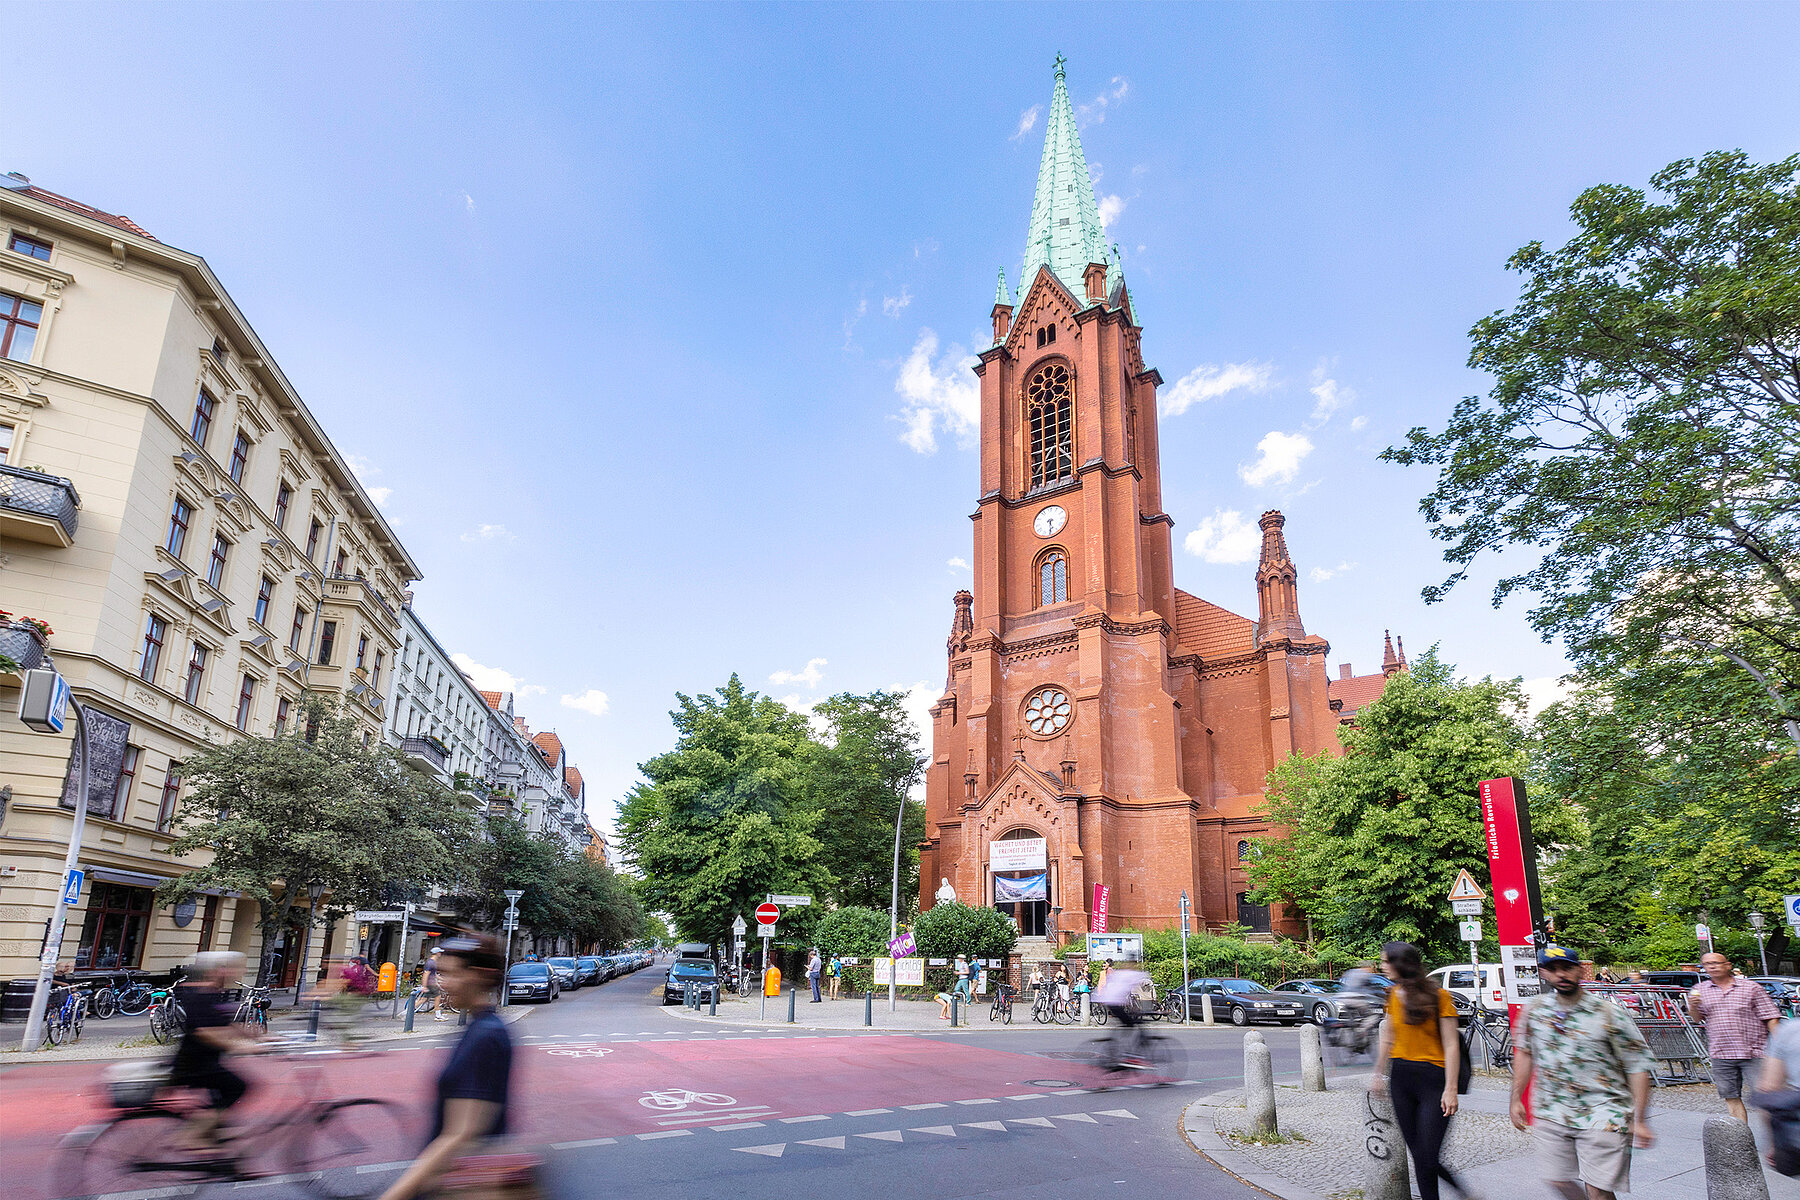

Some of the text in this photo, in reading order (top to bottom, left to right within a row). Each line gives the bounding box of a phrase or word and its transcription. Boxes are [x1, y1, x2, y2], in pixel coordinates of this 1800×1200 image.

[1483, 784, 1499, 859] Friedliche Revolution
[1099, 886, 1109, 912] KIRCHE
